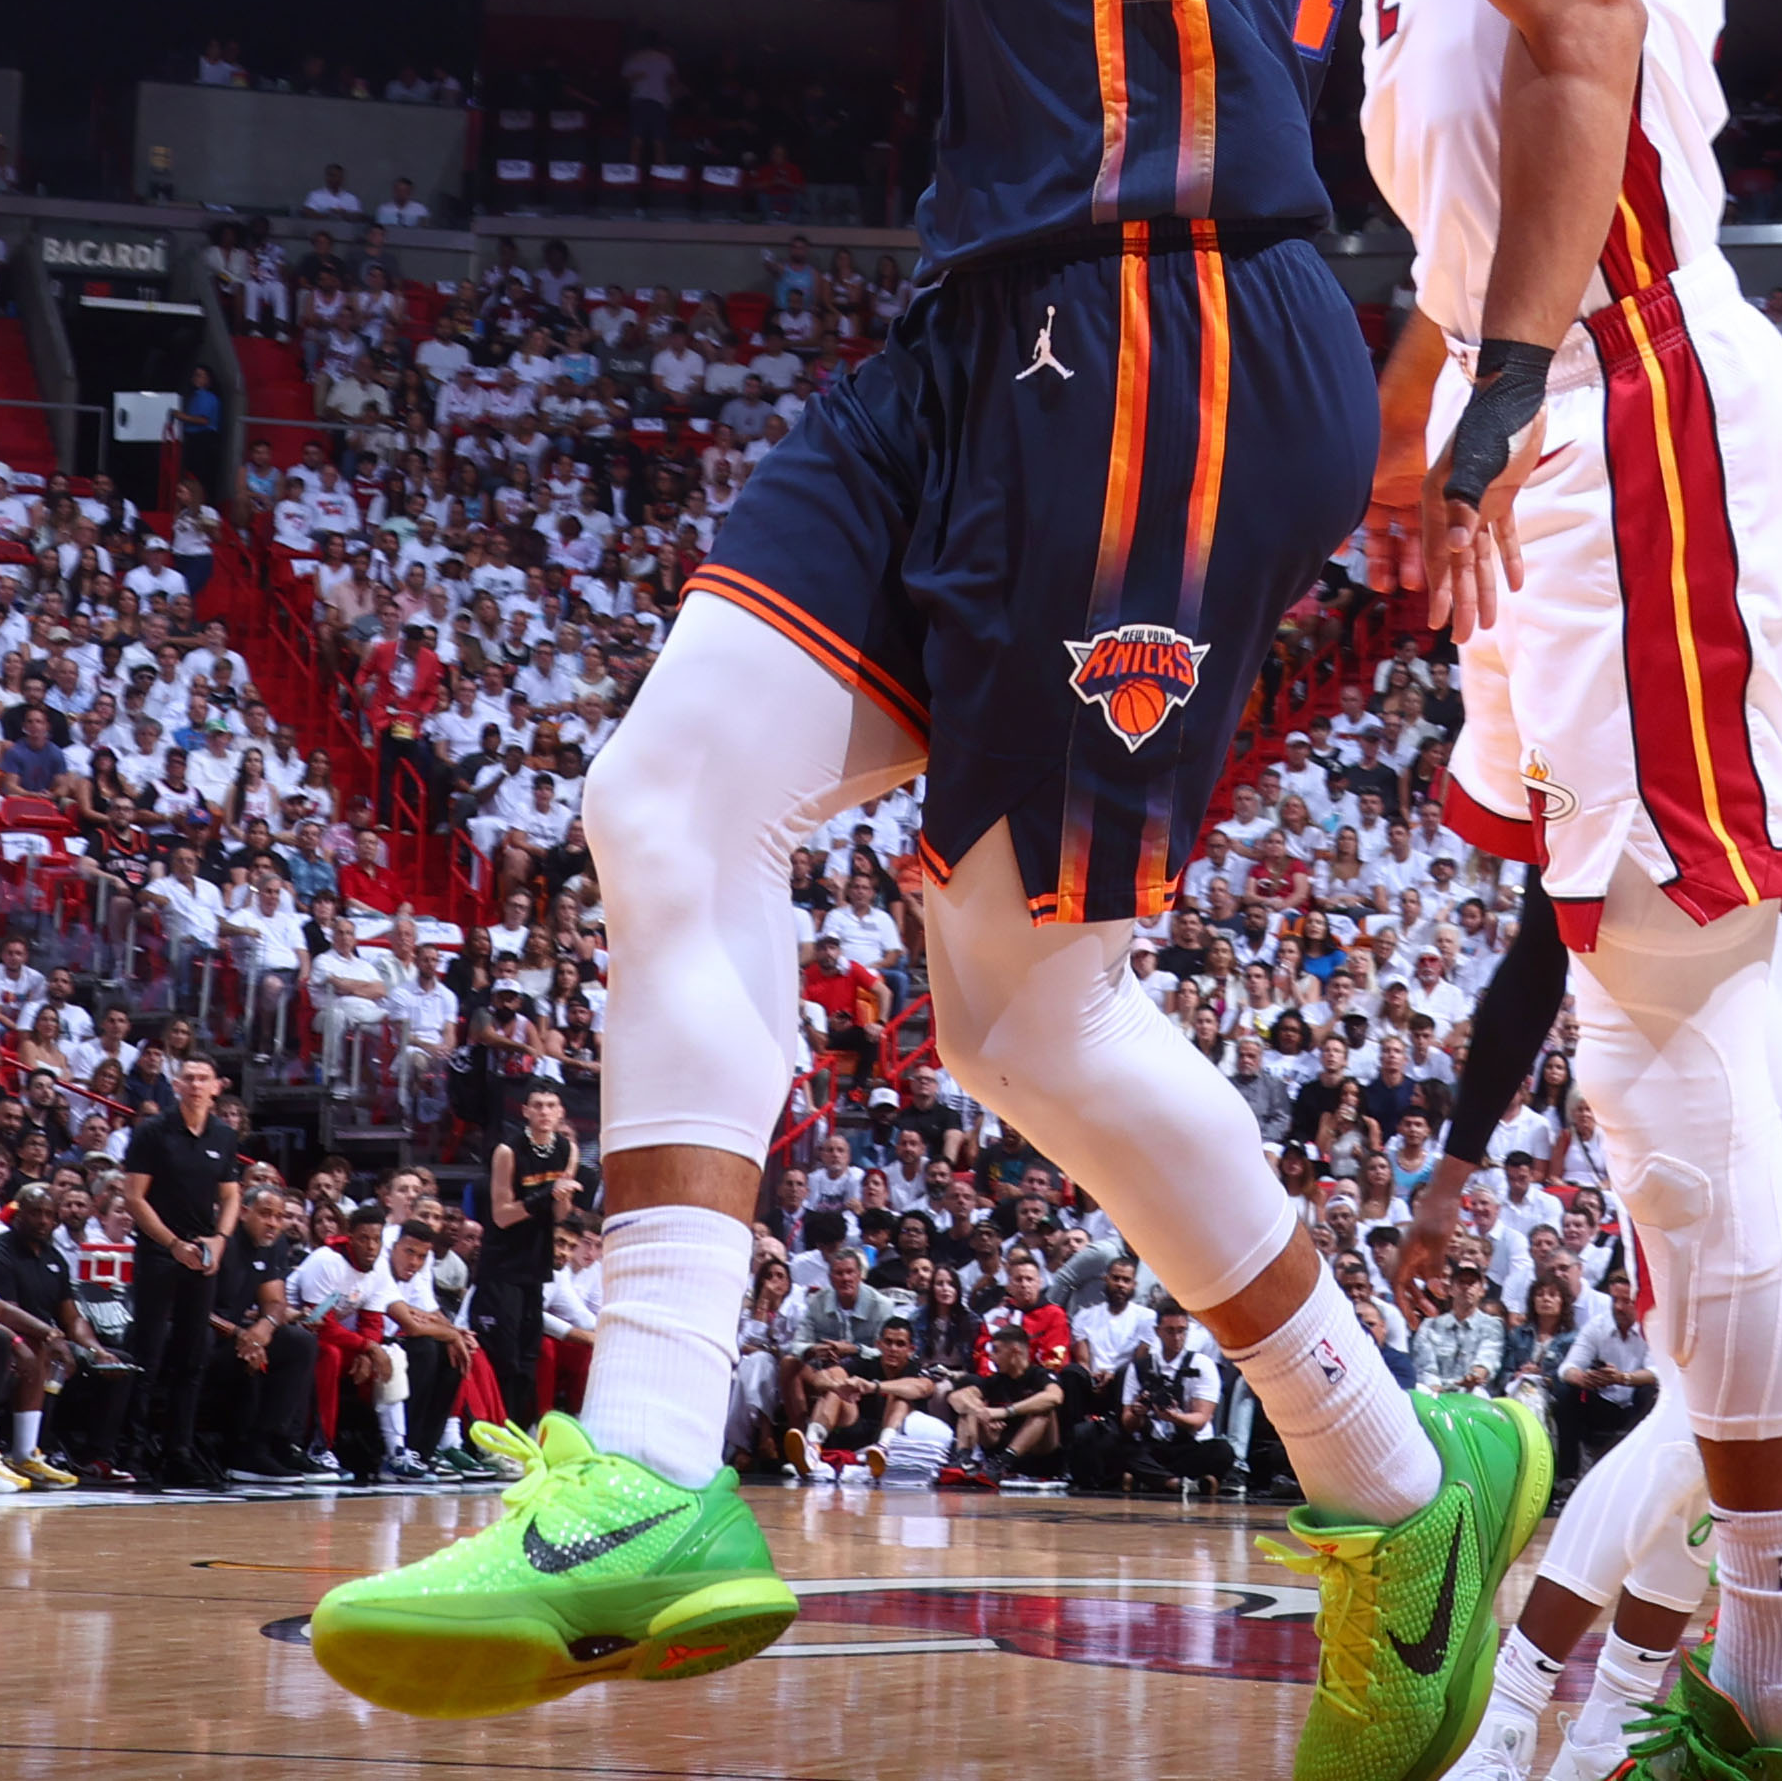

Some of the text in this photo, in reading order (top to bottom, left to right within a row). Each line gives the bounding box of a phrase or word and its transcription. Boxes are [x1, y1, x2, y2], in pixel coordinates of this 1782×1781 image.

[1120, 629, 1173, 644] NEW YORK
[1075, 635, 1196, 688] KNICKS
